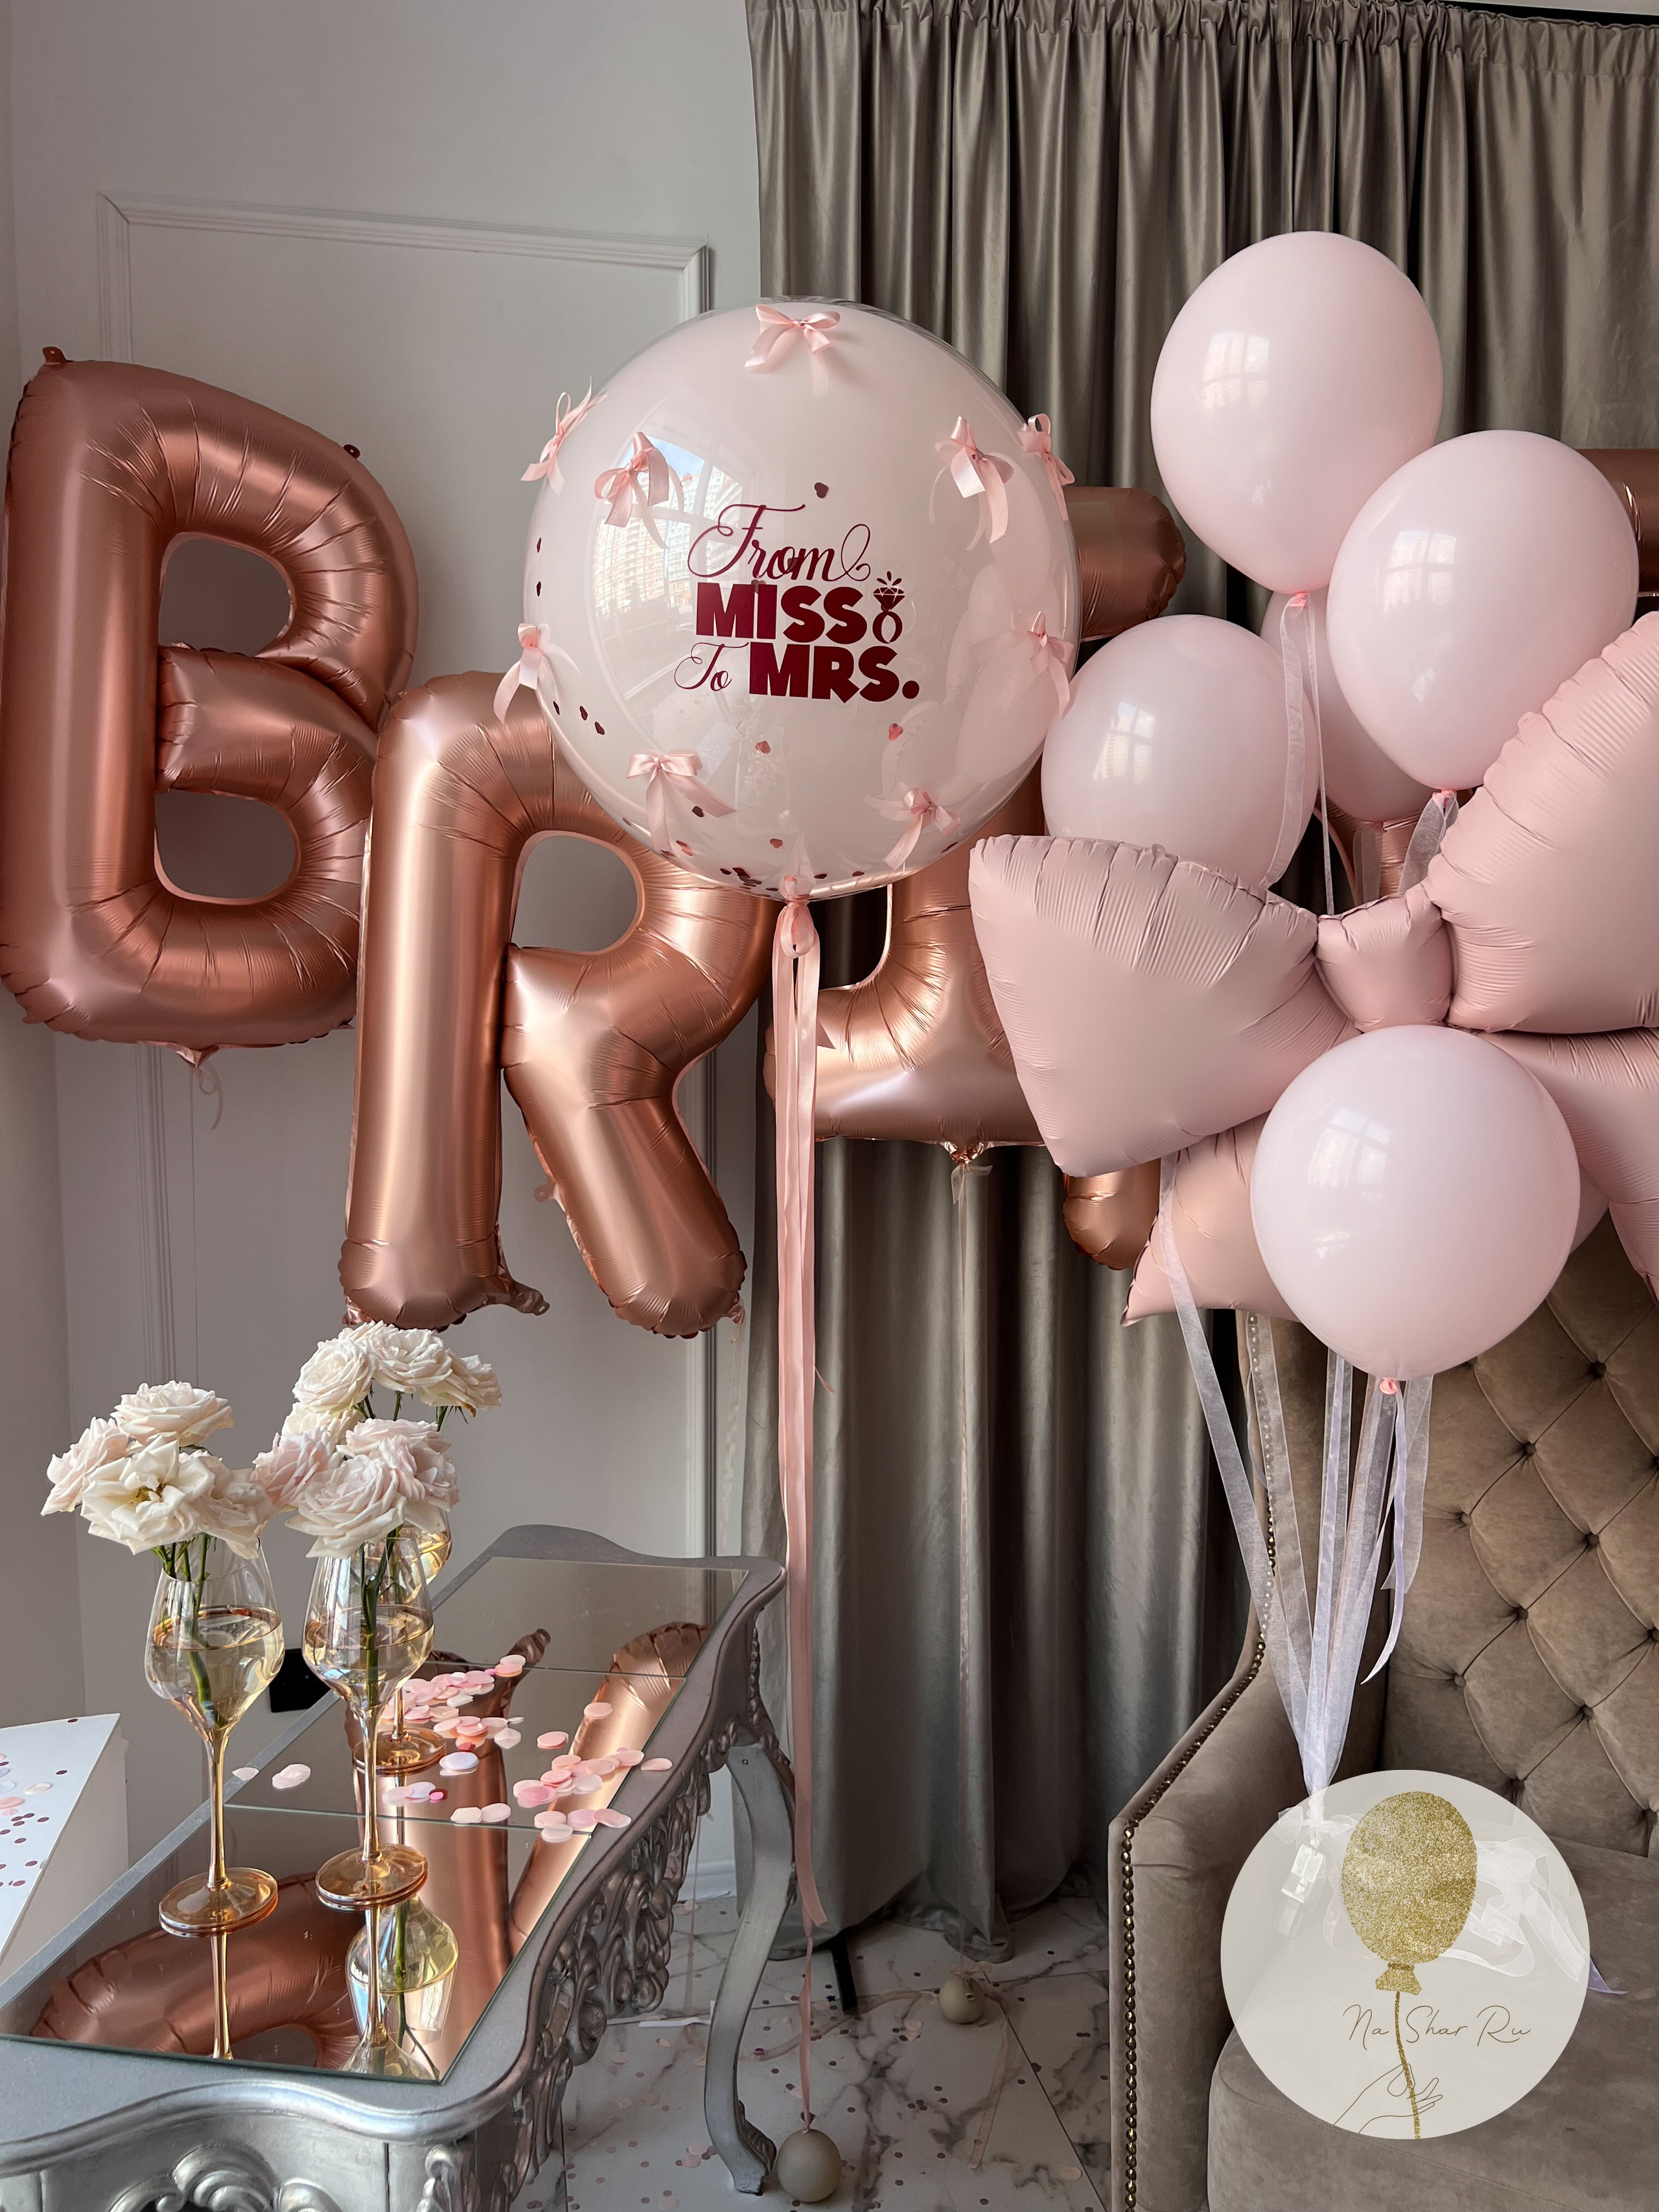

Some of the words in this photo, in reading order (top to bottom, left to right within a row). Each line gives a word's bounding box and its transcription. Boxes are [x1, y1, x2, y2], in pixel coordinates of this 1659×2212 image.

[688, 504, 871, 581] From
[696, 582, 867, 644] MISS
[674, 642, 749, 691] To
[749, 642, 920, 703] MRS.
